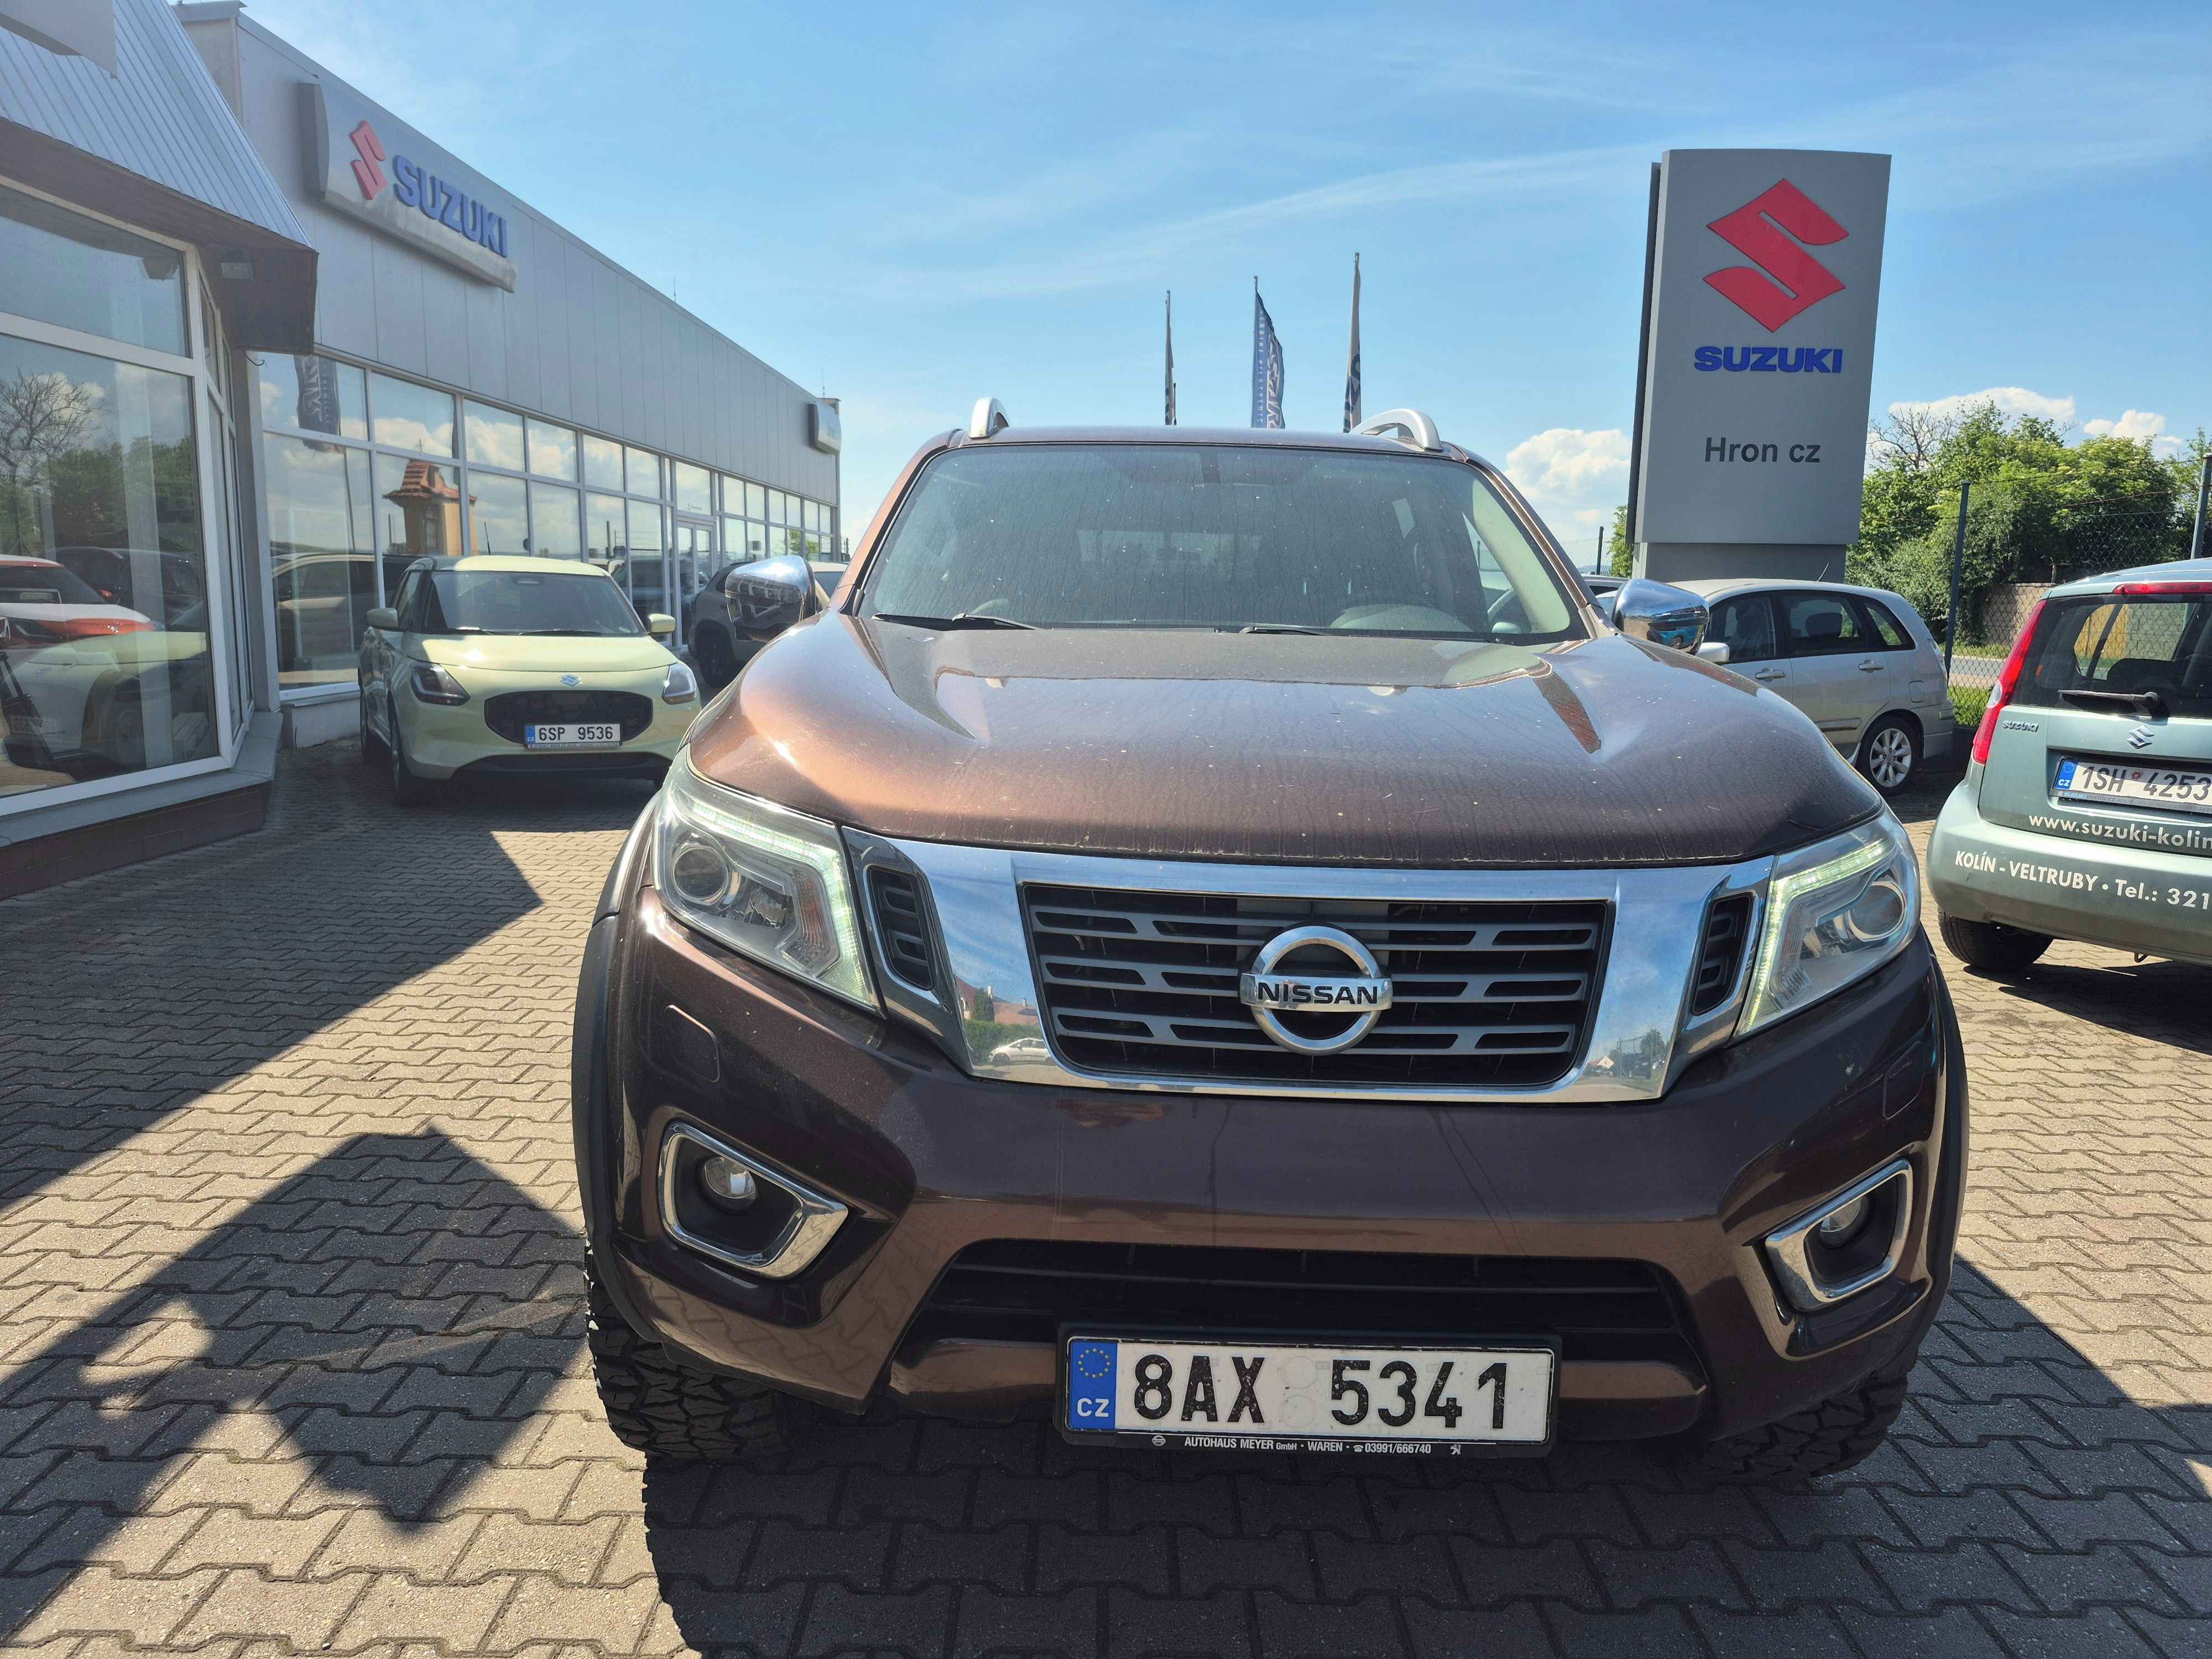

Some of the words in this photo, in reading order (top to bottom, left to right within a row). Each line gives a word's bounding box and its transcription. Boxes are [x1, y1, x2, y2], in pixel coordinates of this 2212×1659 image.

[392, 155, 508, 258] SUZUKI
[1694, 346, 1843, 373] SUZUKI
[1705, 437, 1778, 462] Hron
[1789, 444, 1820, 463] cz
[539, 727, 565, 741] 6SP
[577, 726, 613, 740] 9536
[2002, 720, 2039, 732] SUZUKI
[2058, 778, 2070, 787] CZ
[2082, 766, 2126, 792] 1SH
[2143, 772, 2211, 801] 4253
[1955, 851, 1996, 873] KOLÍN
[2009, 860, 2098, 891] VELTRUBY
[2115, 879, 2158, 902] Tel.:
[2167, 888, 2210, 910] 321
[1258, 982, 1378, 1005] NISSAN
[1133, 1354, 1266, 1423] 8AX
[1329, 1358, 1507, 1430] 5341
[1076, 1397, 1109, 1418] CZ
[1185, 1437, 1237, 1449] AUTOHAUS
[1240, 1438, 1274, 1449] MEYER
[1307, 1442, 1343, 1452] WAREN
[1364, 1443, 1432, 1454] 03991/666740
